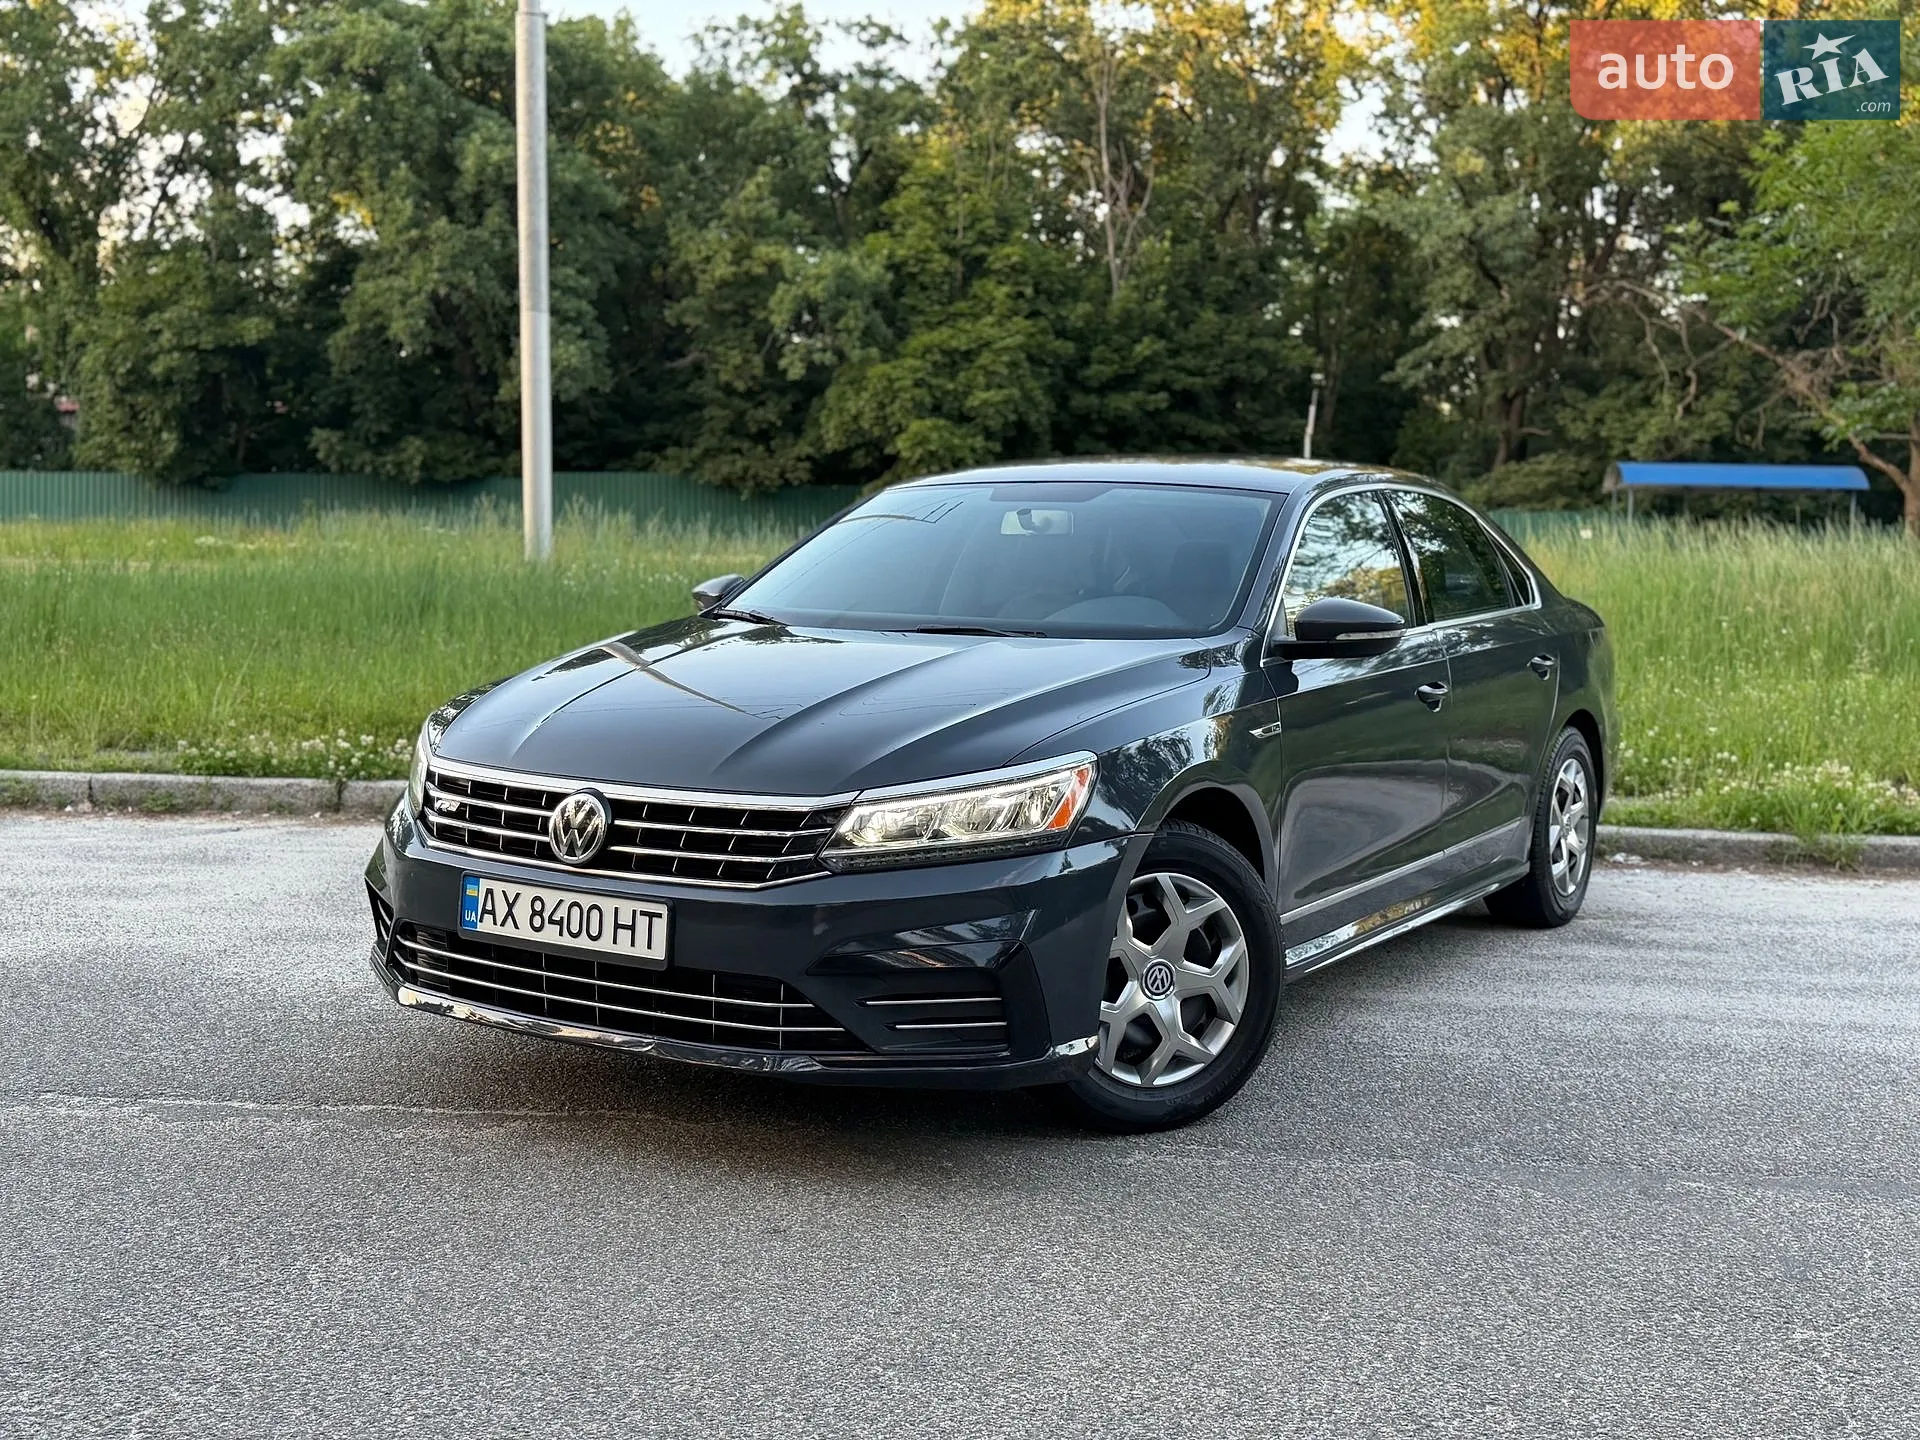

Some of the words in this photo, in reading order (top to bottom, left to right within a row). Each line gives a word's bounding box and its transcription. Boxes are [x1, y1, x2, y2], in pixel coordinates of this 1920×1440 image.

[465, 909, 477, 923] UA
[478, 887, 522, 930] AX
[529, 895, 604, 942] 8400
[612, 906, 663, 950] HT
